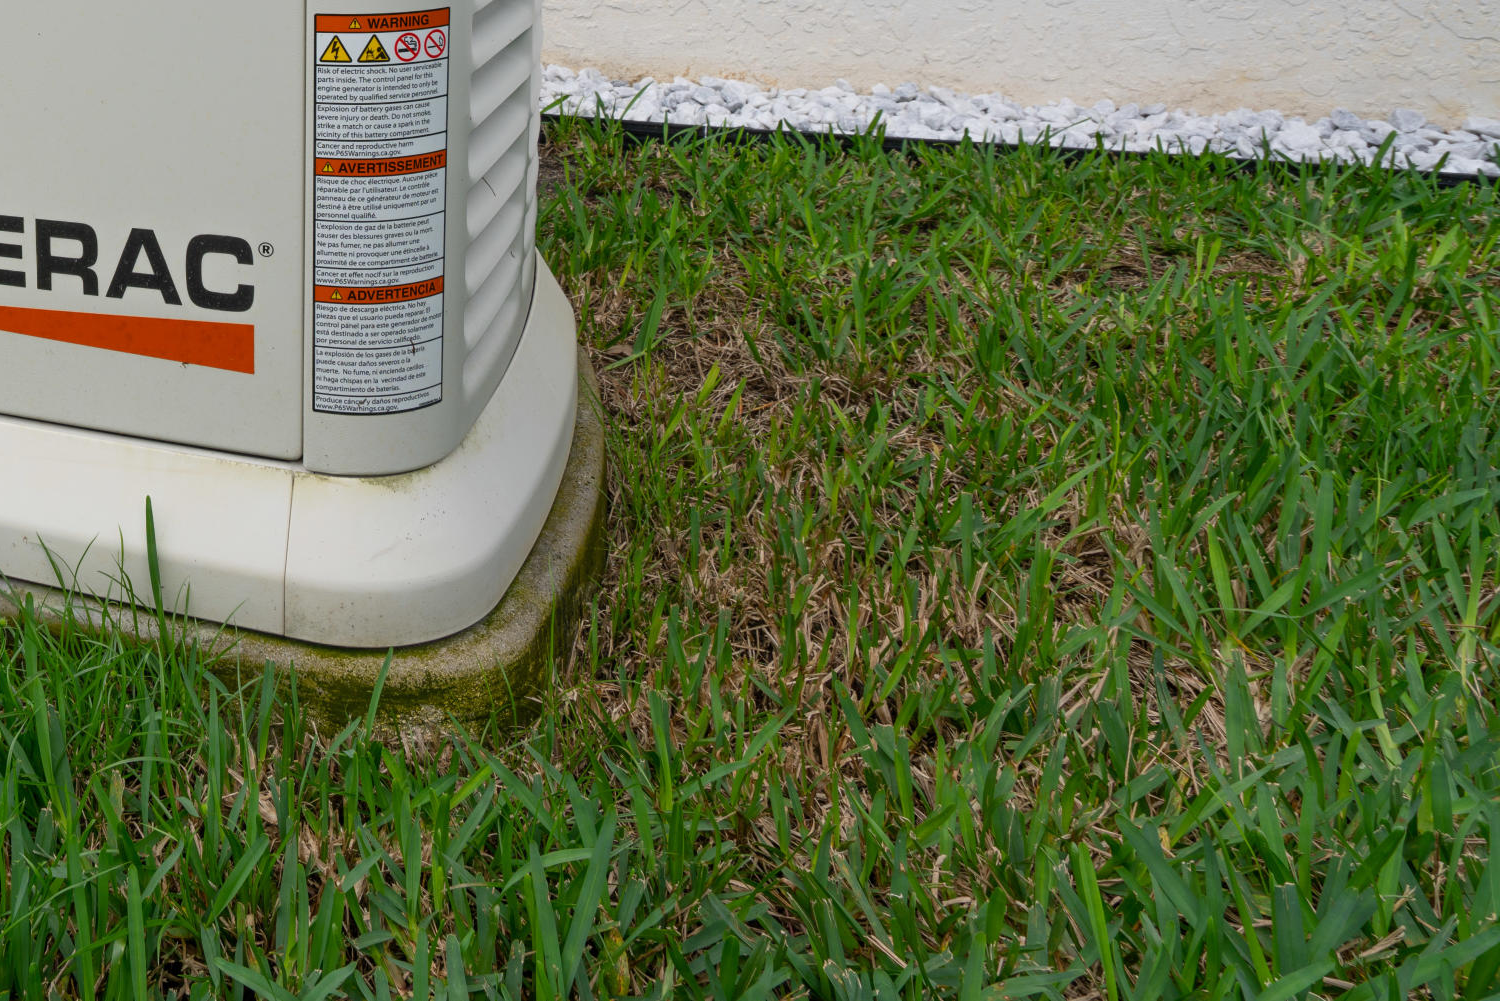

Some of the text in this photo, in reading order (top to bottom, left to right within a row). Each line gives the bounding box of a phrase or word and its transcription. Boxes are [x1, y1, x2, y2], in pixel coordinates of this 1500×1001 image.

[367, 14, 429, 29] WARNING
[338, 153, 444, 174] AVERTISSEMENT
[347, 282, 436, 301] ADVERTENCIA
